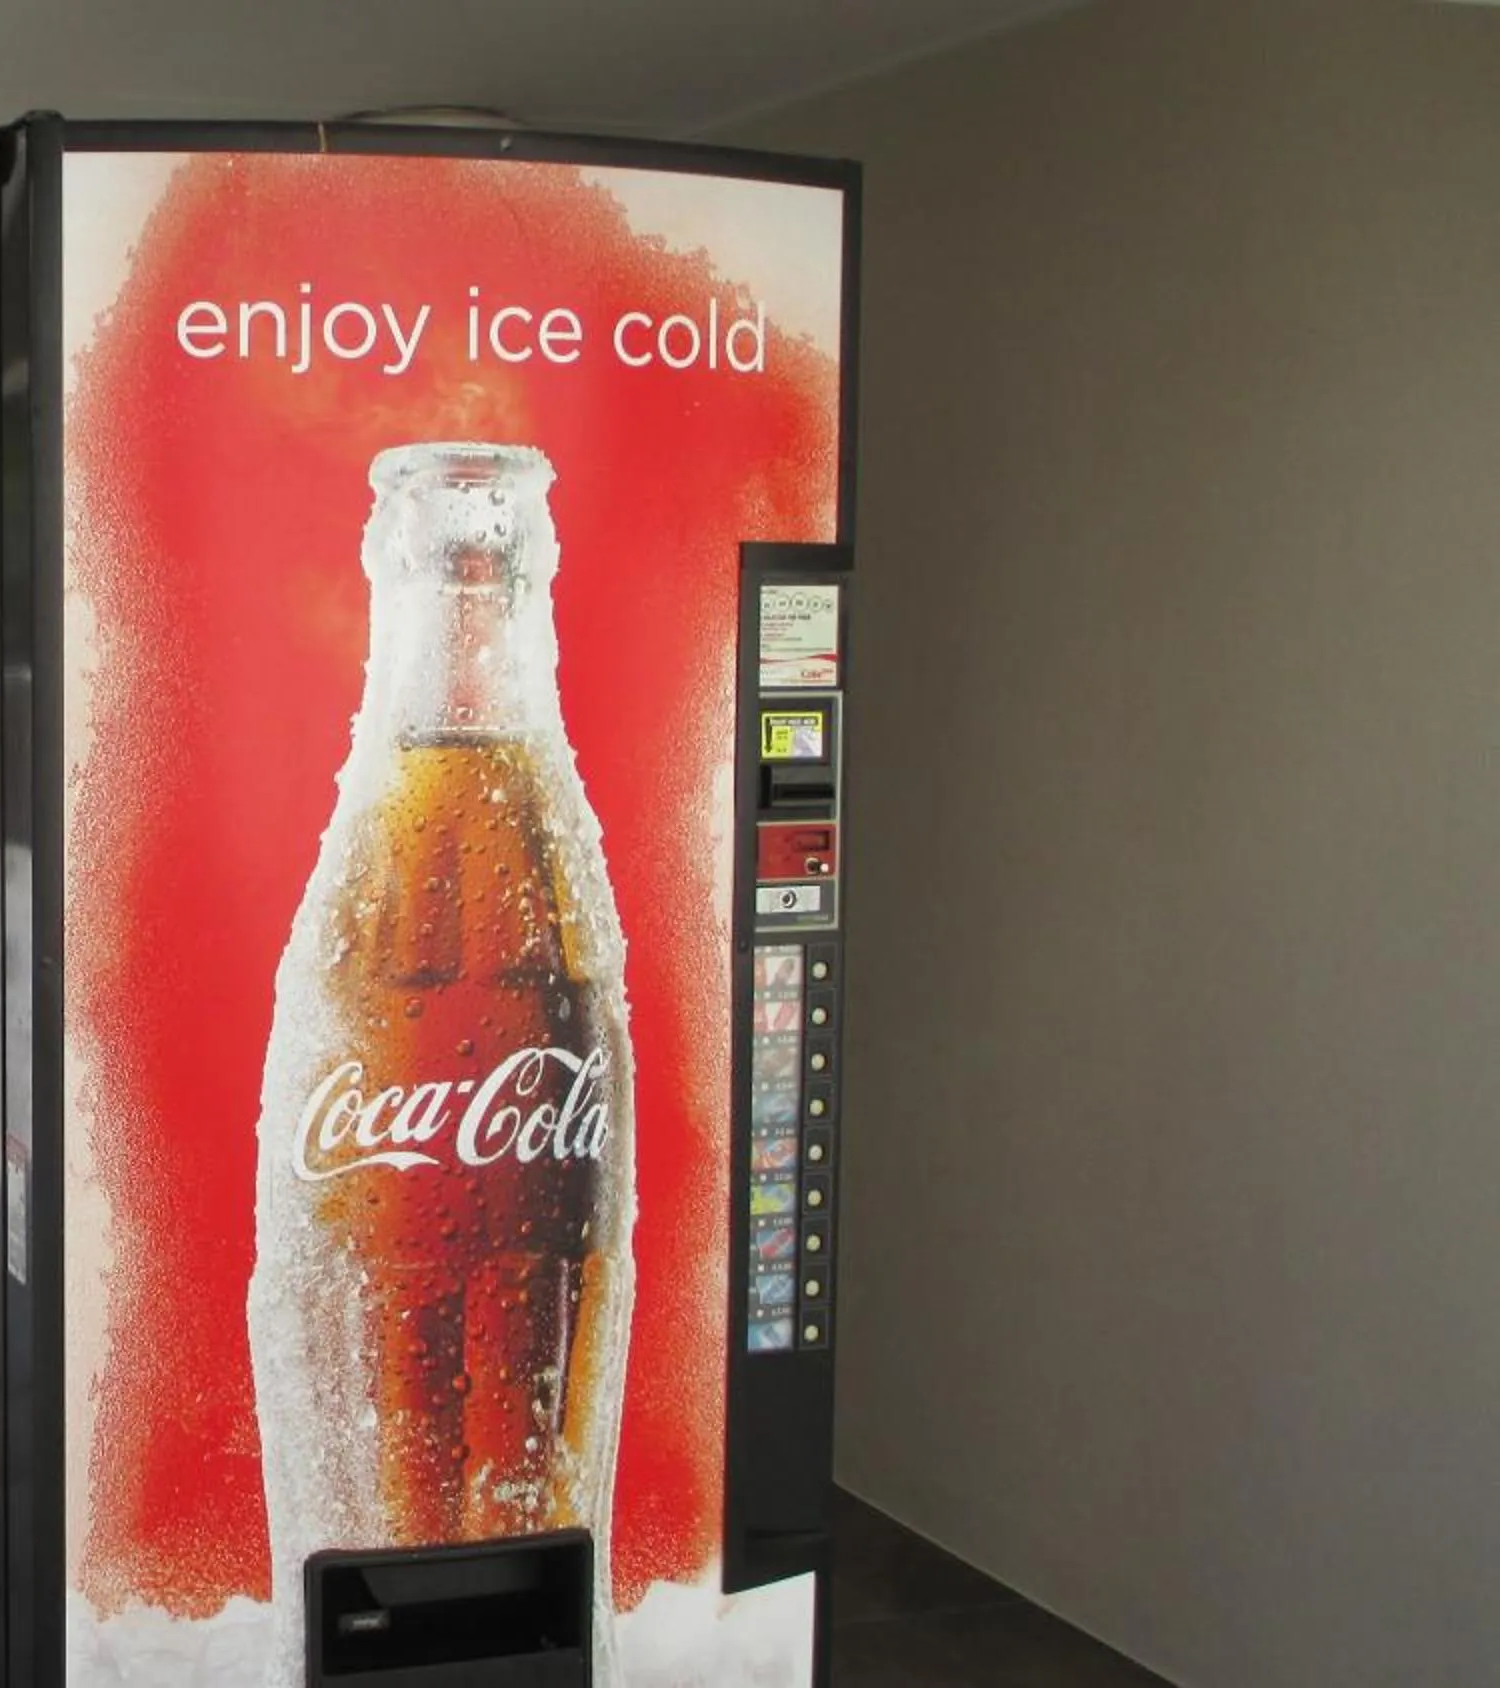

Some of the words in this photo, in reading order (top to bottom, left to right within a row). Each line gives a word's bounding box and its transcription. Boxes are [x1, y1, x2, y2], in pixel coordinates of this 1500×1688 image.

[176, 282, 431, 376] enjoy
[468, 286, 584, 365] ice
[613, 296, 766, 374] cold
[293, 1046, 611, 1181] Coca-Cola
